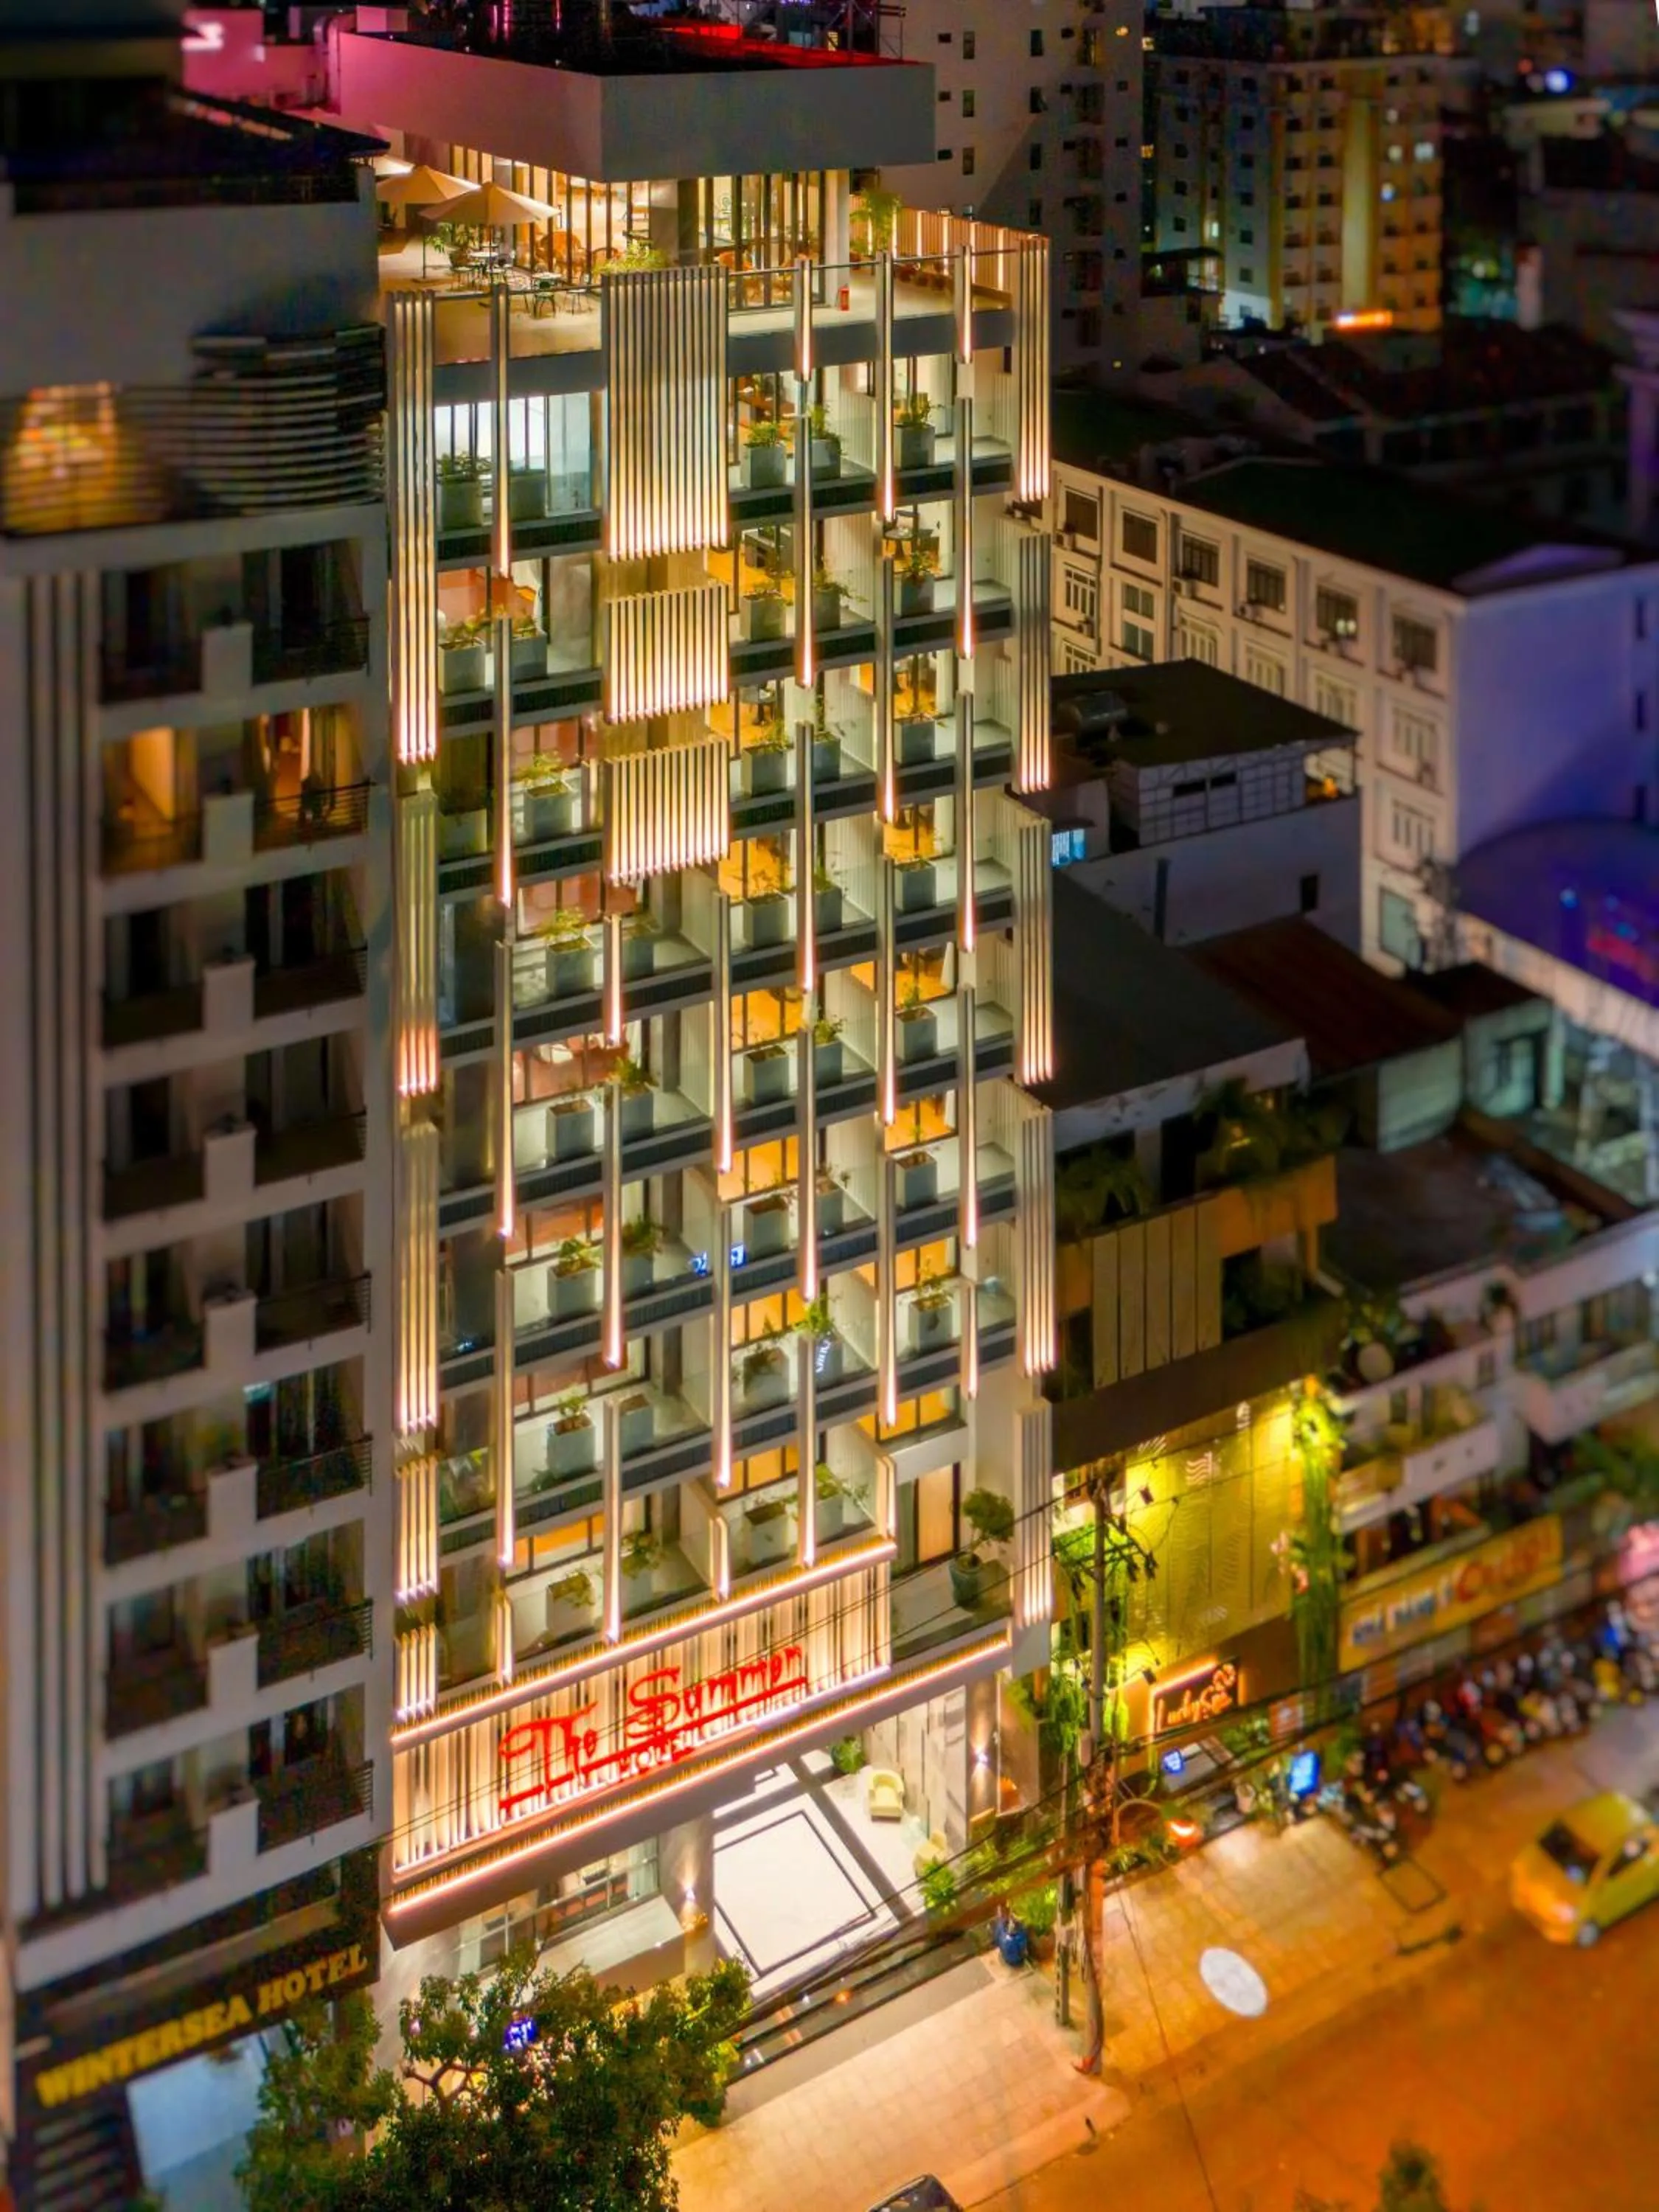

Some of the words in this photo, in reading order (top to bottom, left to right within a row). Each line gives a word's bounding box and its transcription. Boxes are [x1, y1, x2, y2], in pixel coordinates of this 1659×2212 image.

[498, 1700, 598, 1794] The
[625, 1646, 802, 1738] Summer
[35, 1994, 252, 2108] WINTERSEA
[257, 1944, 368, 2014] HOTEL
